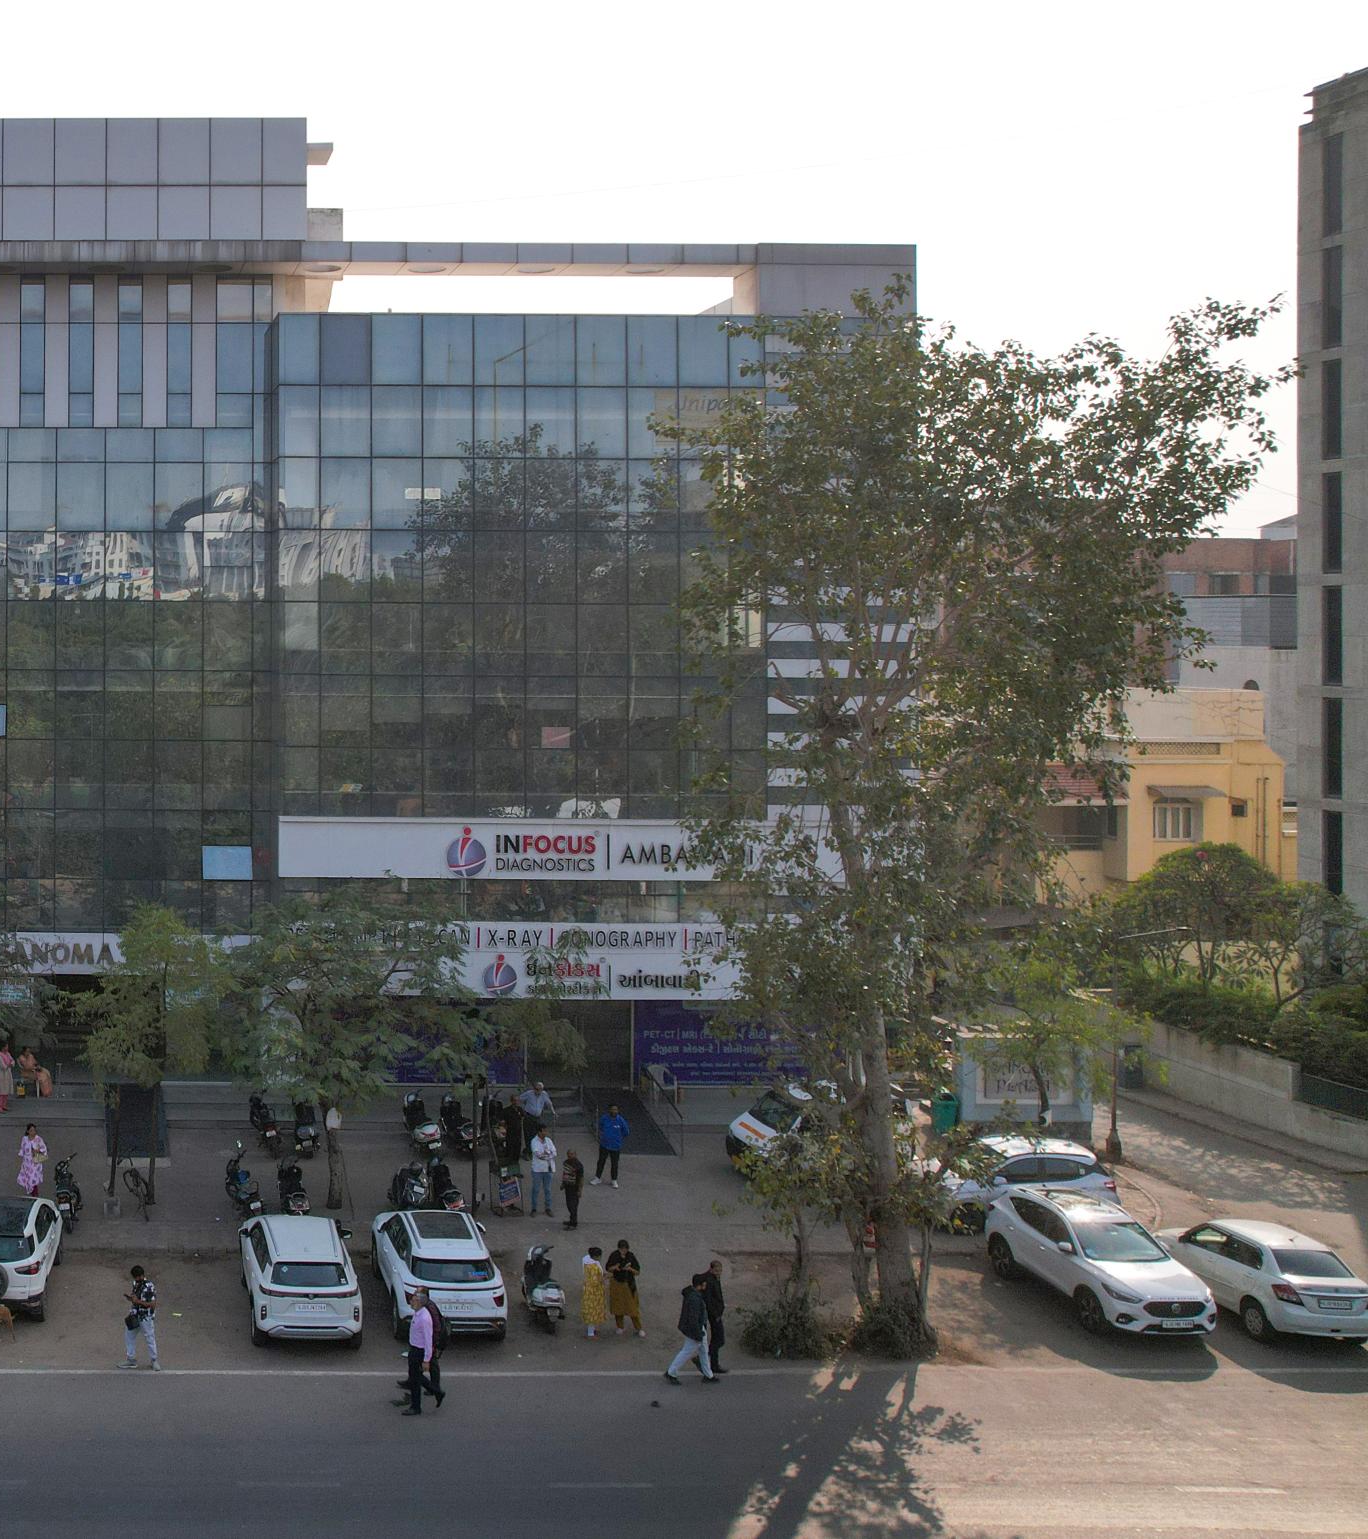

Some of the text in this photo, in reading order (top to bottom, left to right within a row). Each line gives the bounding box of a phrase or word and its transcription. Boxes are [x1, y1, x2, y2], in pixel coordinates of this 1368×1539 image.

[496, 834, 596, 855] INFOCUS
[496, 857, 595, 873] DIAGNOSTICS
[488, 929, 543, 946] X-RAY
[643, 1030, 675, 1039] PET-CT
